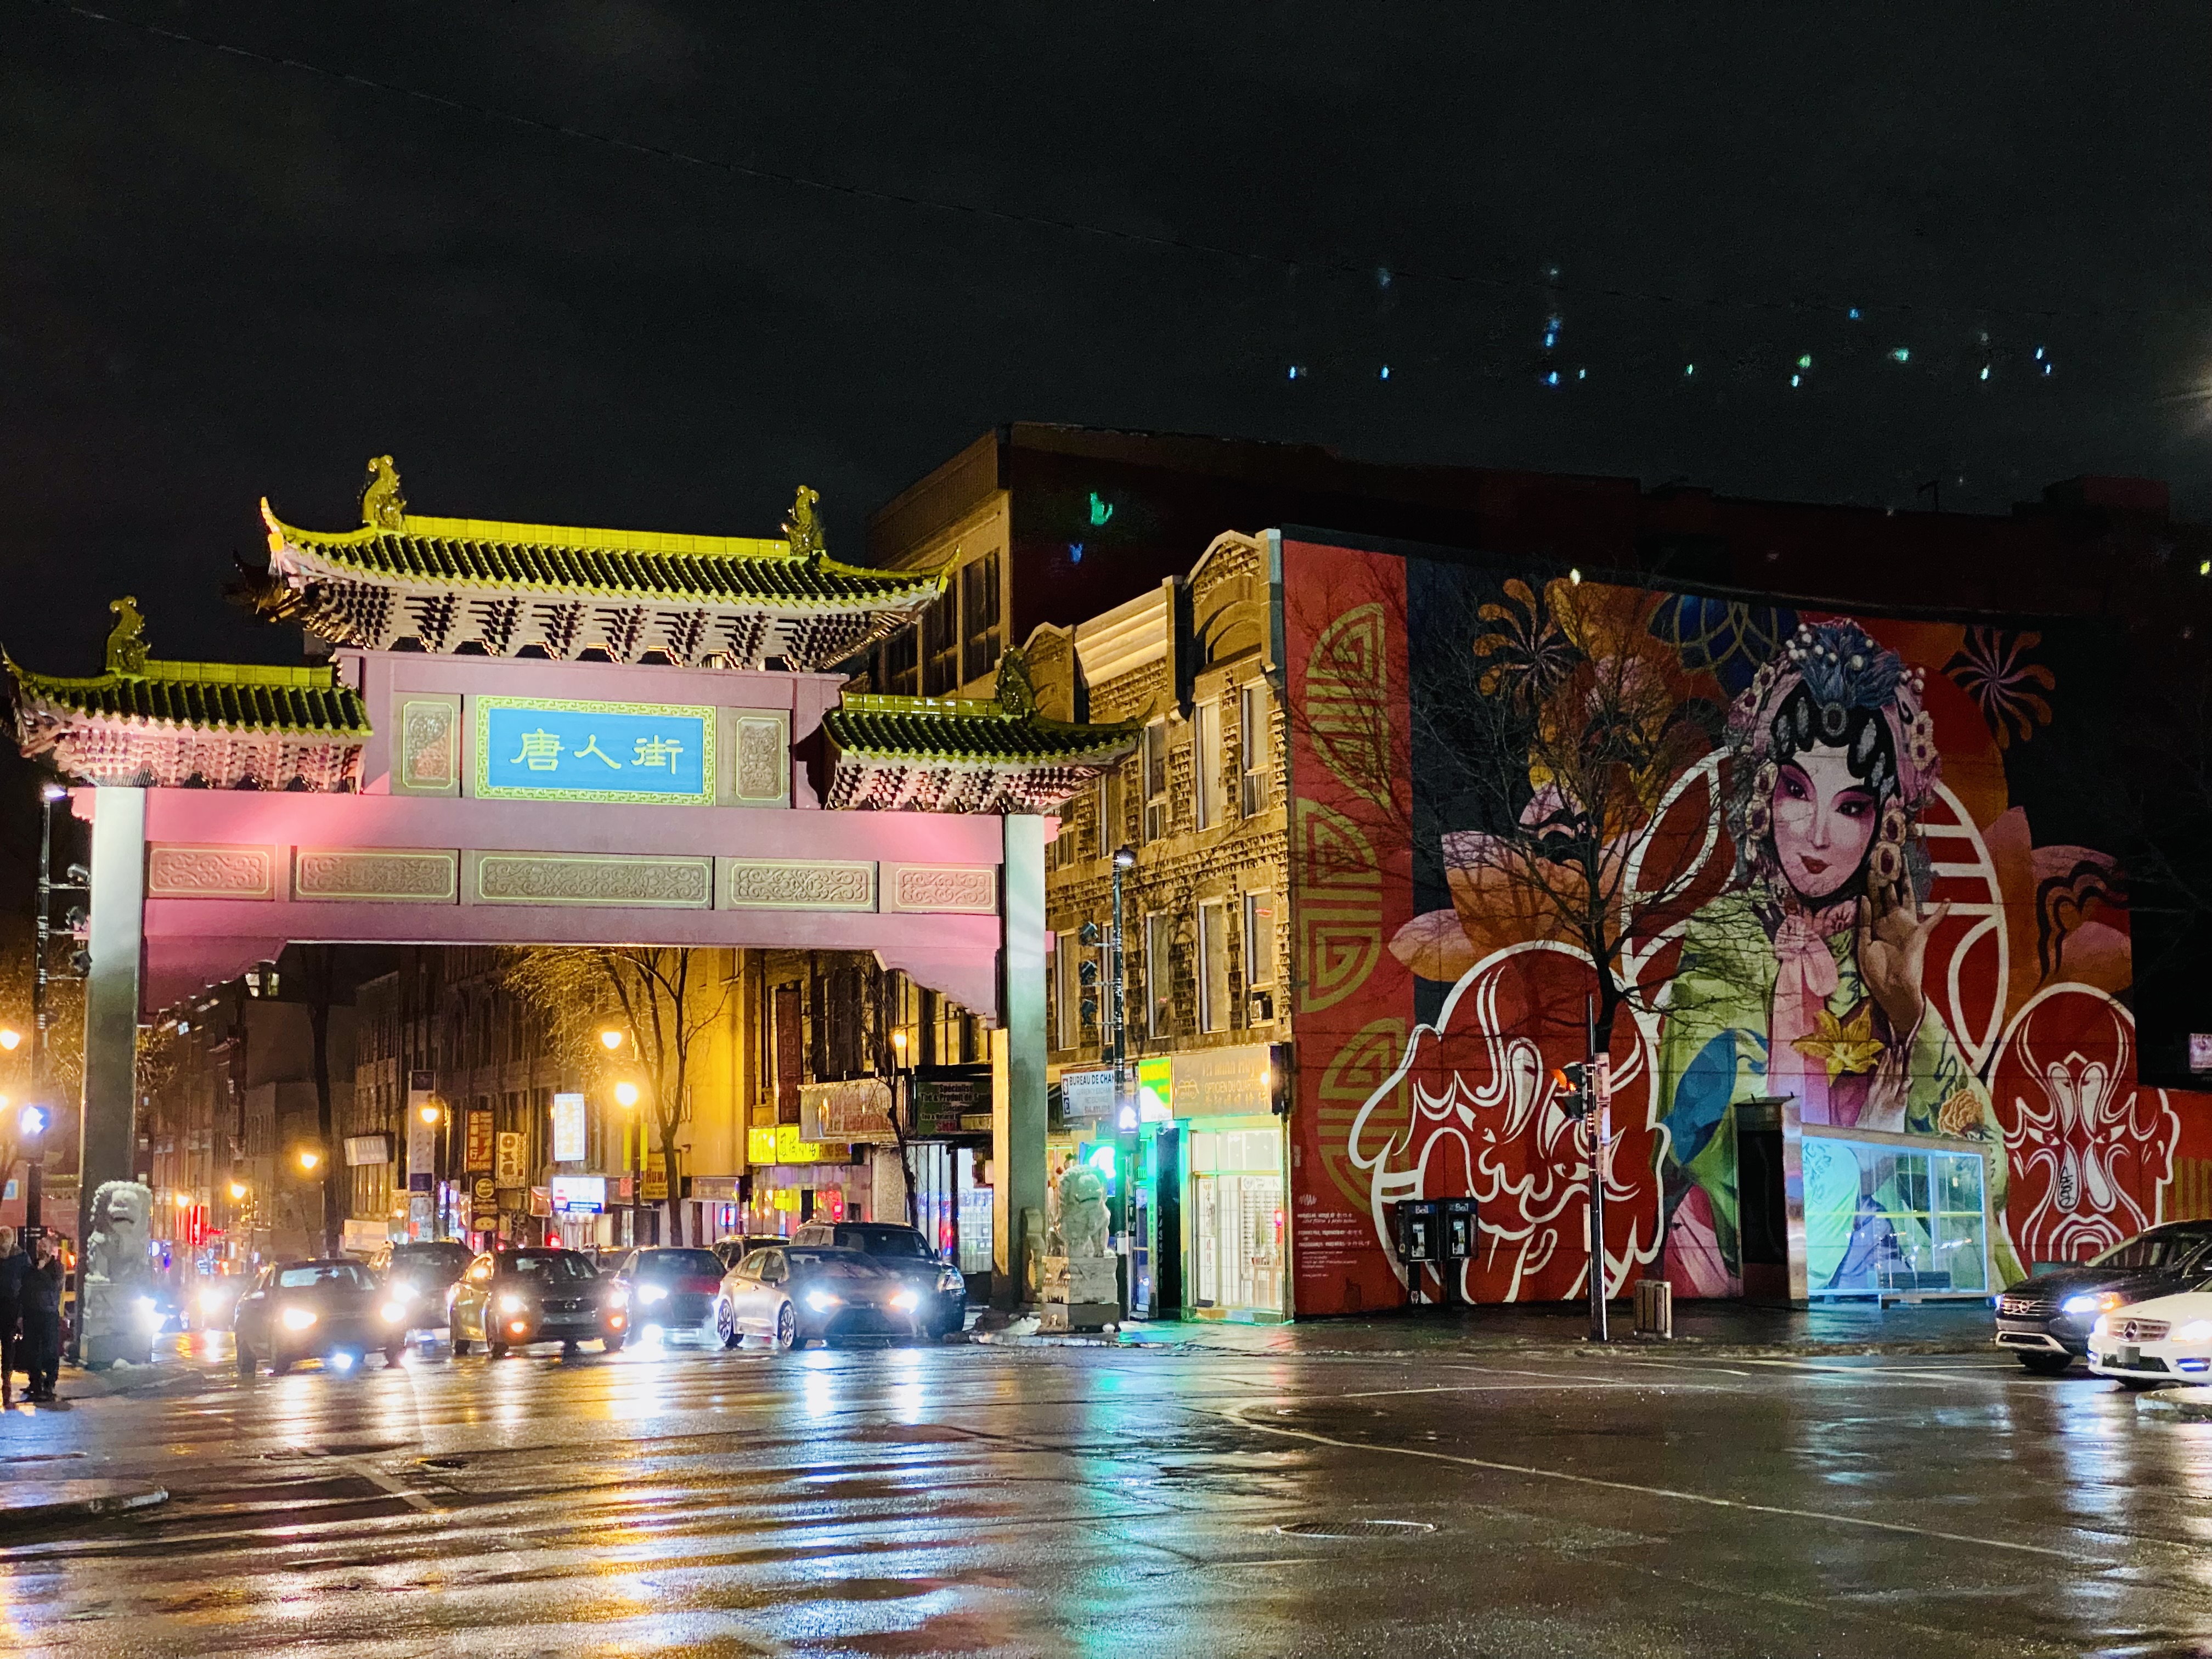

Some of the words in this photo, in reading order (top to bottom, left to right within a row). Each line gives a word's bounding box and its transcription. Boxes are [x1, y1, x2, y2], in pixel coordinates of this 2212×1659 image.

[510, 728, 684, 775] 唐人街
[1069, 1075, 1091, 1086] BUREAU
[1092, 1074, 1099, 1085] DE
[1100, 1074, 1115, 1084] CHAN
[1415, 1205, 1429, 1214] Bell
[1455, 1203, 1469, 1211] Bell
